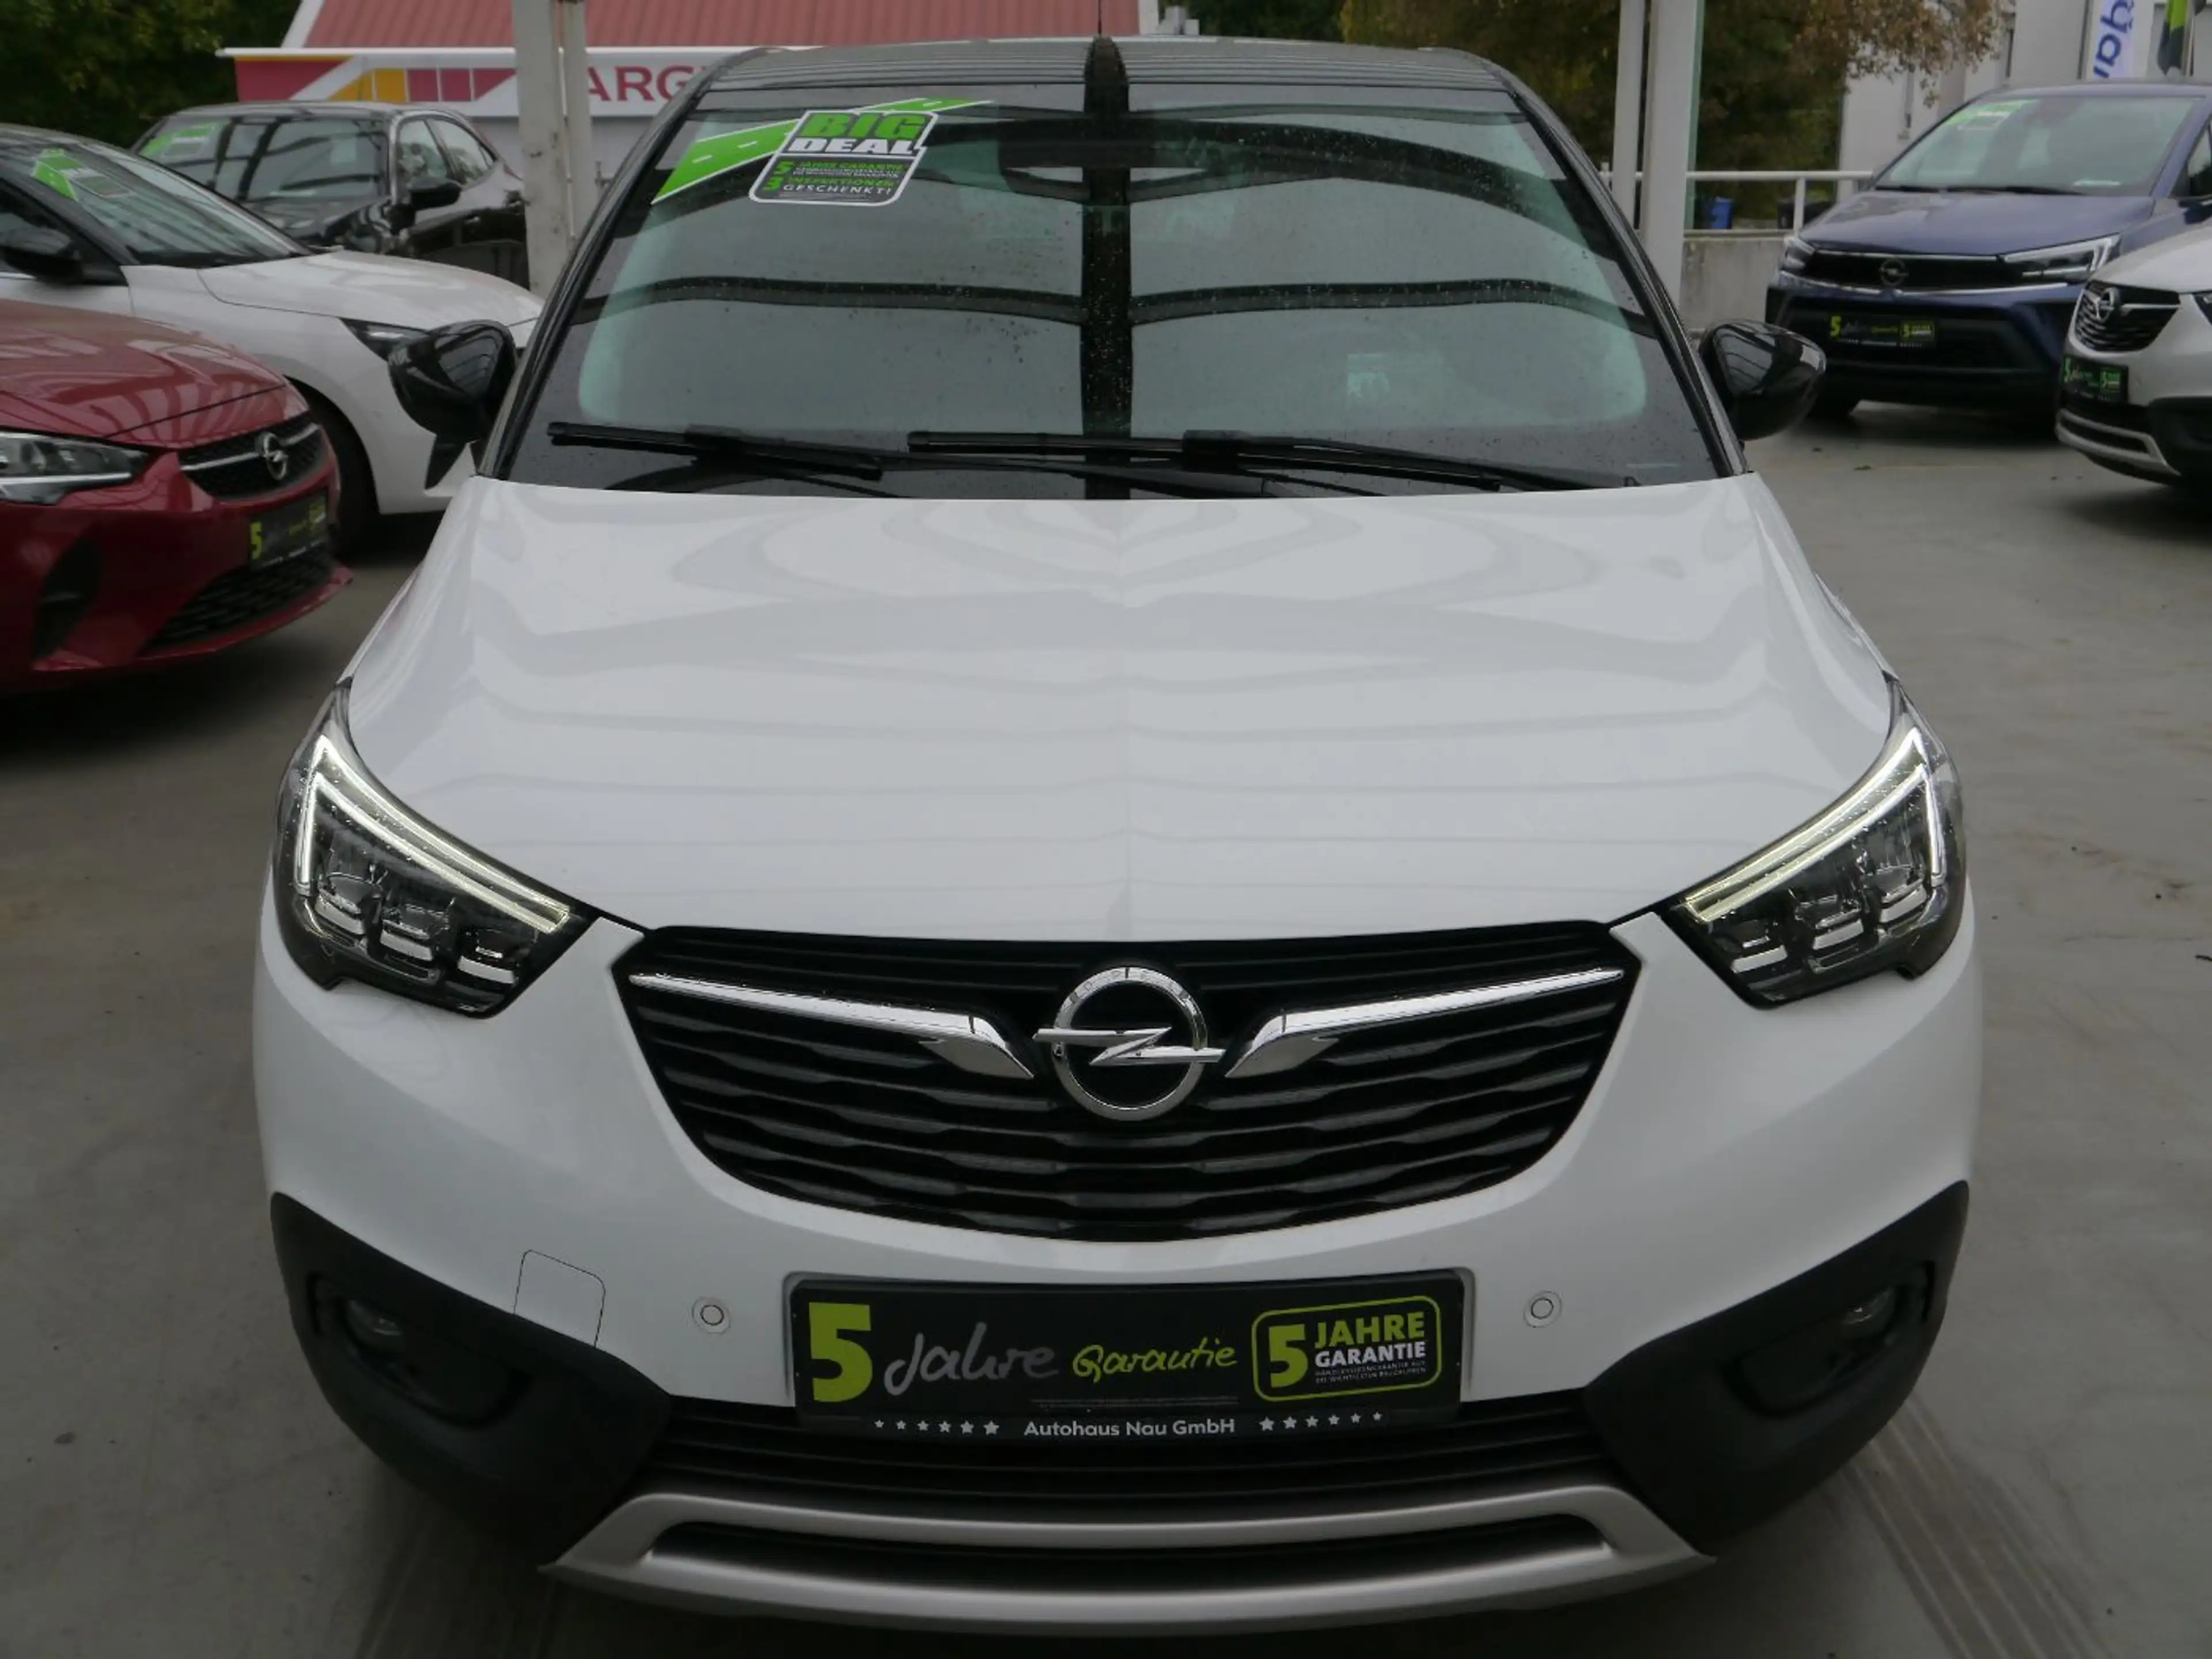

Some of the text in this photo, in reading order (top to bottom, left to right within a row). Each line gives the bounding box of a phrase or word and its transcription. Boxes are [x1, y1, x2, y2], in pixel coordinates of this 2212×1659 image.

[586, 65, 706, 102] ARG
[800, 112, 926, 140] BIG
[787, 137, 915, 154] DEAL
[1314, 1311, 1425, 1349] JAHRE
[809, 1302, 1238, 1402] 5 Jahre Garantie
[1268, 1324, 1308, 1388] 5
[1315, 1340, 1426, 1368] GARANTIE
[1024, 1419, 1235, 1436] Autohaus Nau GmbH
